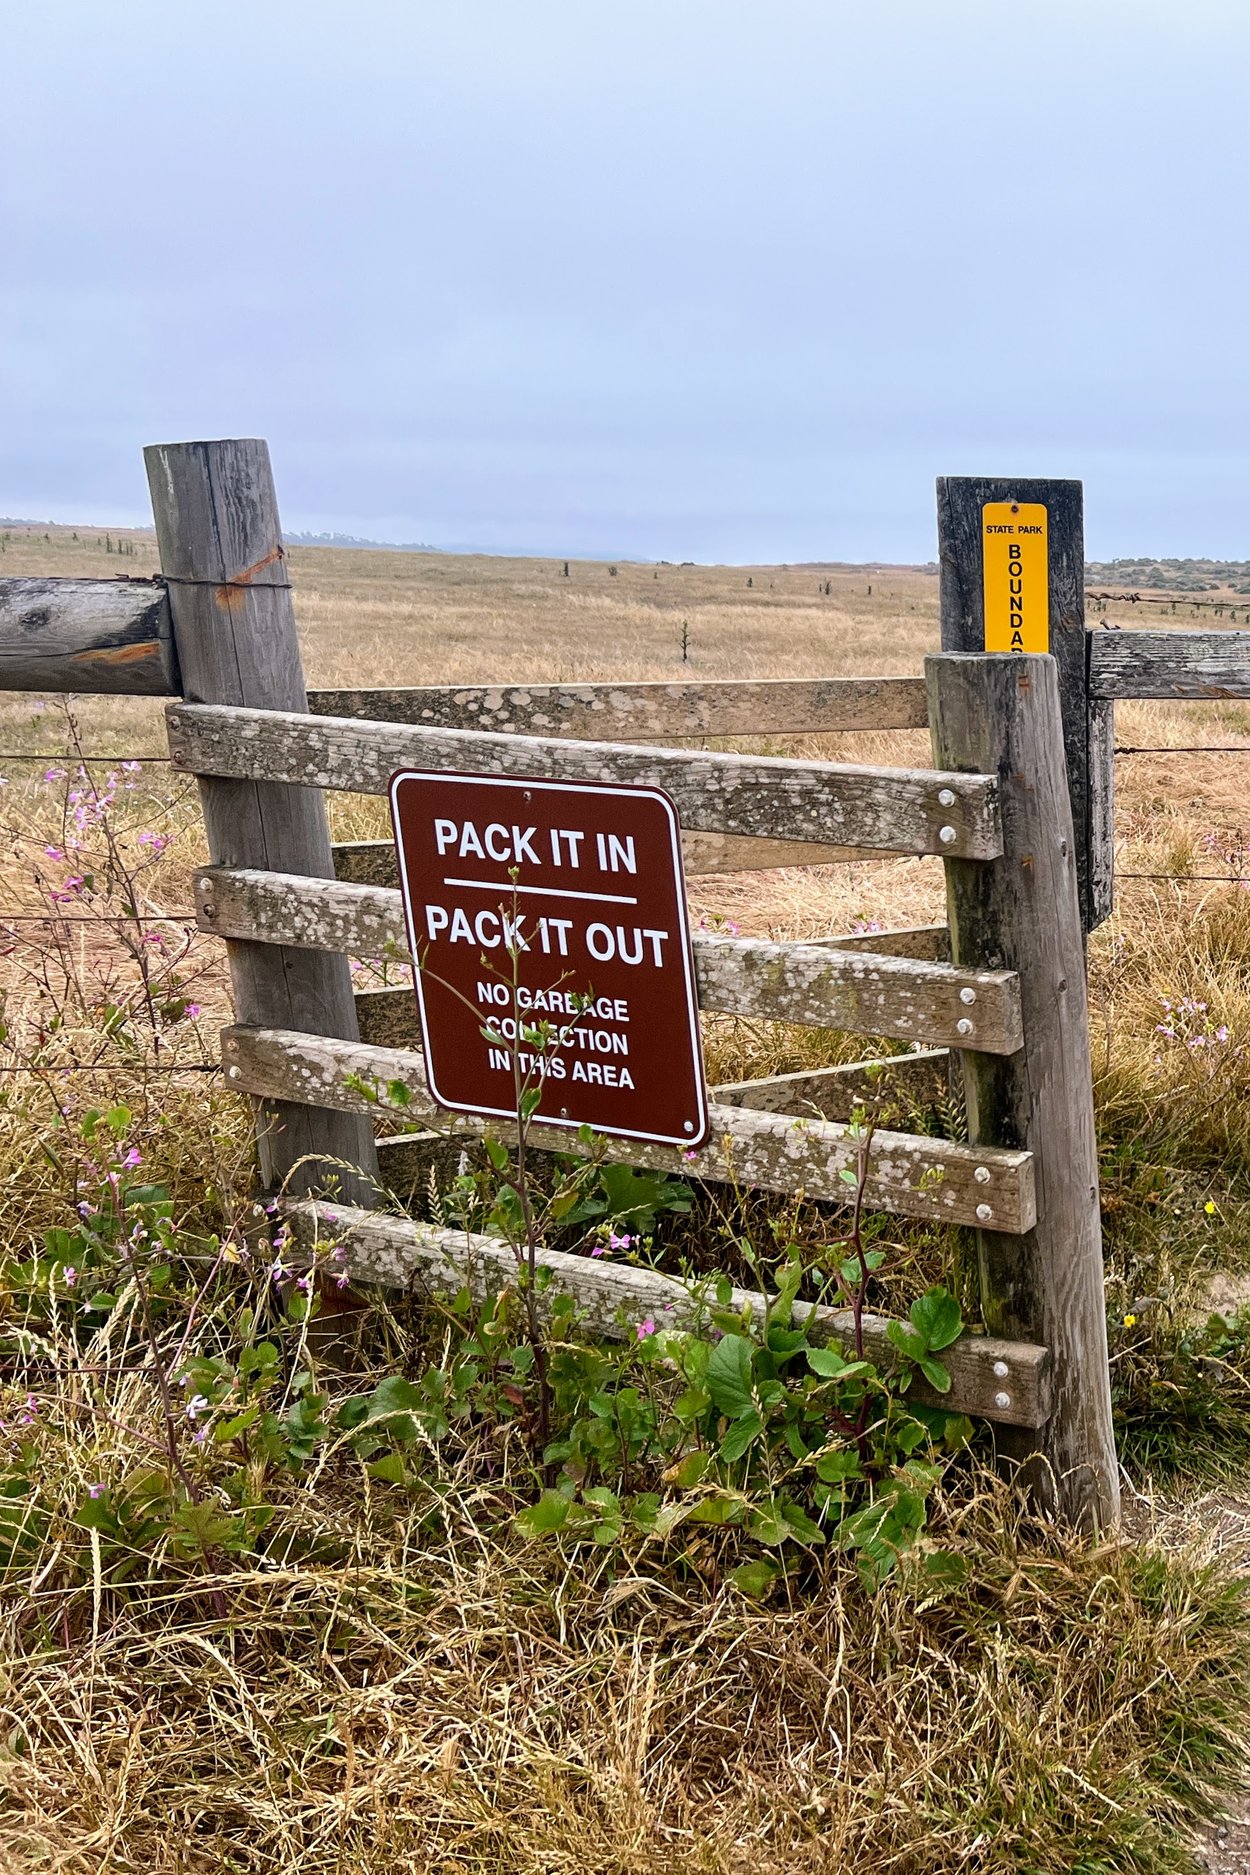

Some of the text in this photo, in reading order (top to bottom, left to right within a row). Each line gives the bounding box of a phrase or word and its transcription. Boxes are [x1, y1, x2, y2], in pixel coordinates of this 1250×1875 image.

[986, 525, 1043, 534] STATE PARK
[1008, 544, 1024, 653] BOUNDA
[434, 818, 637, 874] PACK IT IN
[425, 905, 669, 968] PACK IT OUT
[476, 982, 510, 1006] NO
[488, 1049, 635, 1090] IN THIS AREA
